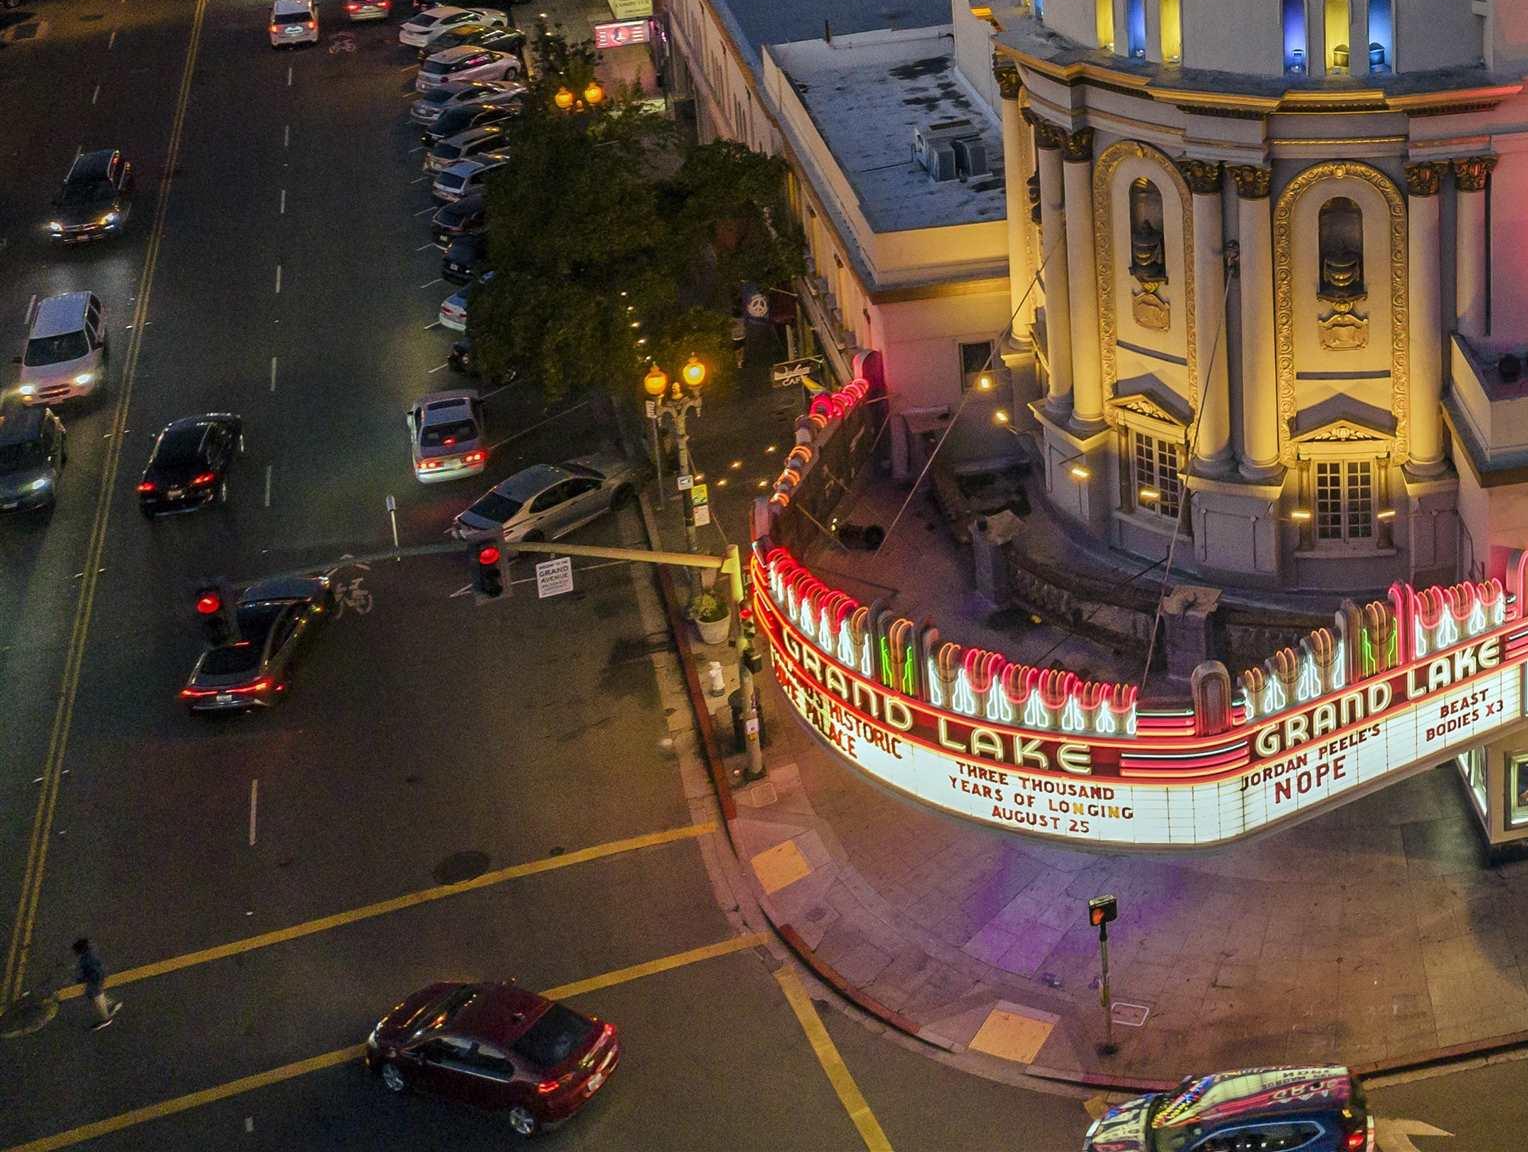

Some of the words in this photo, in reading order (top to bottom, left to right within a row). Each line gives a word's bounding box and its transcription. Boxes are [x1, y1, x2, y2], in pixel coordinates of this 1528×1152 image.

[539, 565, 569, 577] GRAND
[541, 573, 569, 584] AVENUE
[782, 626, 914, 732] GRAND
[937, 716, 1092, 775] LAKE
[1256, 680, 1393, 758] GRAND
[1406, 637, 1500, 700] LAKE
[1439, 688, 1490, 719] BEAST
[829, 700, 903, 760] HISTORIC
[1425, 711, 1480, 742] BODIES
[1485, 699, 1504, 718] X3
[1239, 751, 1308, 792] JORDAN
[1318, 723, 1381, 759] PEELE'S
[949, 774, 1004, 802] YEARS
[1013, 792, 1036, 809] OF
[1048, 798, 1135, 820] LONGING
[955, 760, 1009, 787] THREE
[1018, 776, 1115, 801] THOUSAND
[1274, 756, 1347, 805] NOPE
[992, 804, 1061, 830] AUGUST
[1068, 818, 1091, 834] 25
